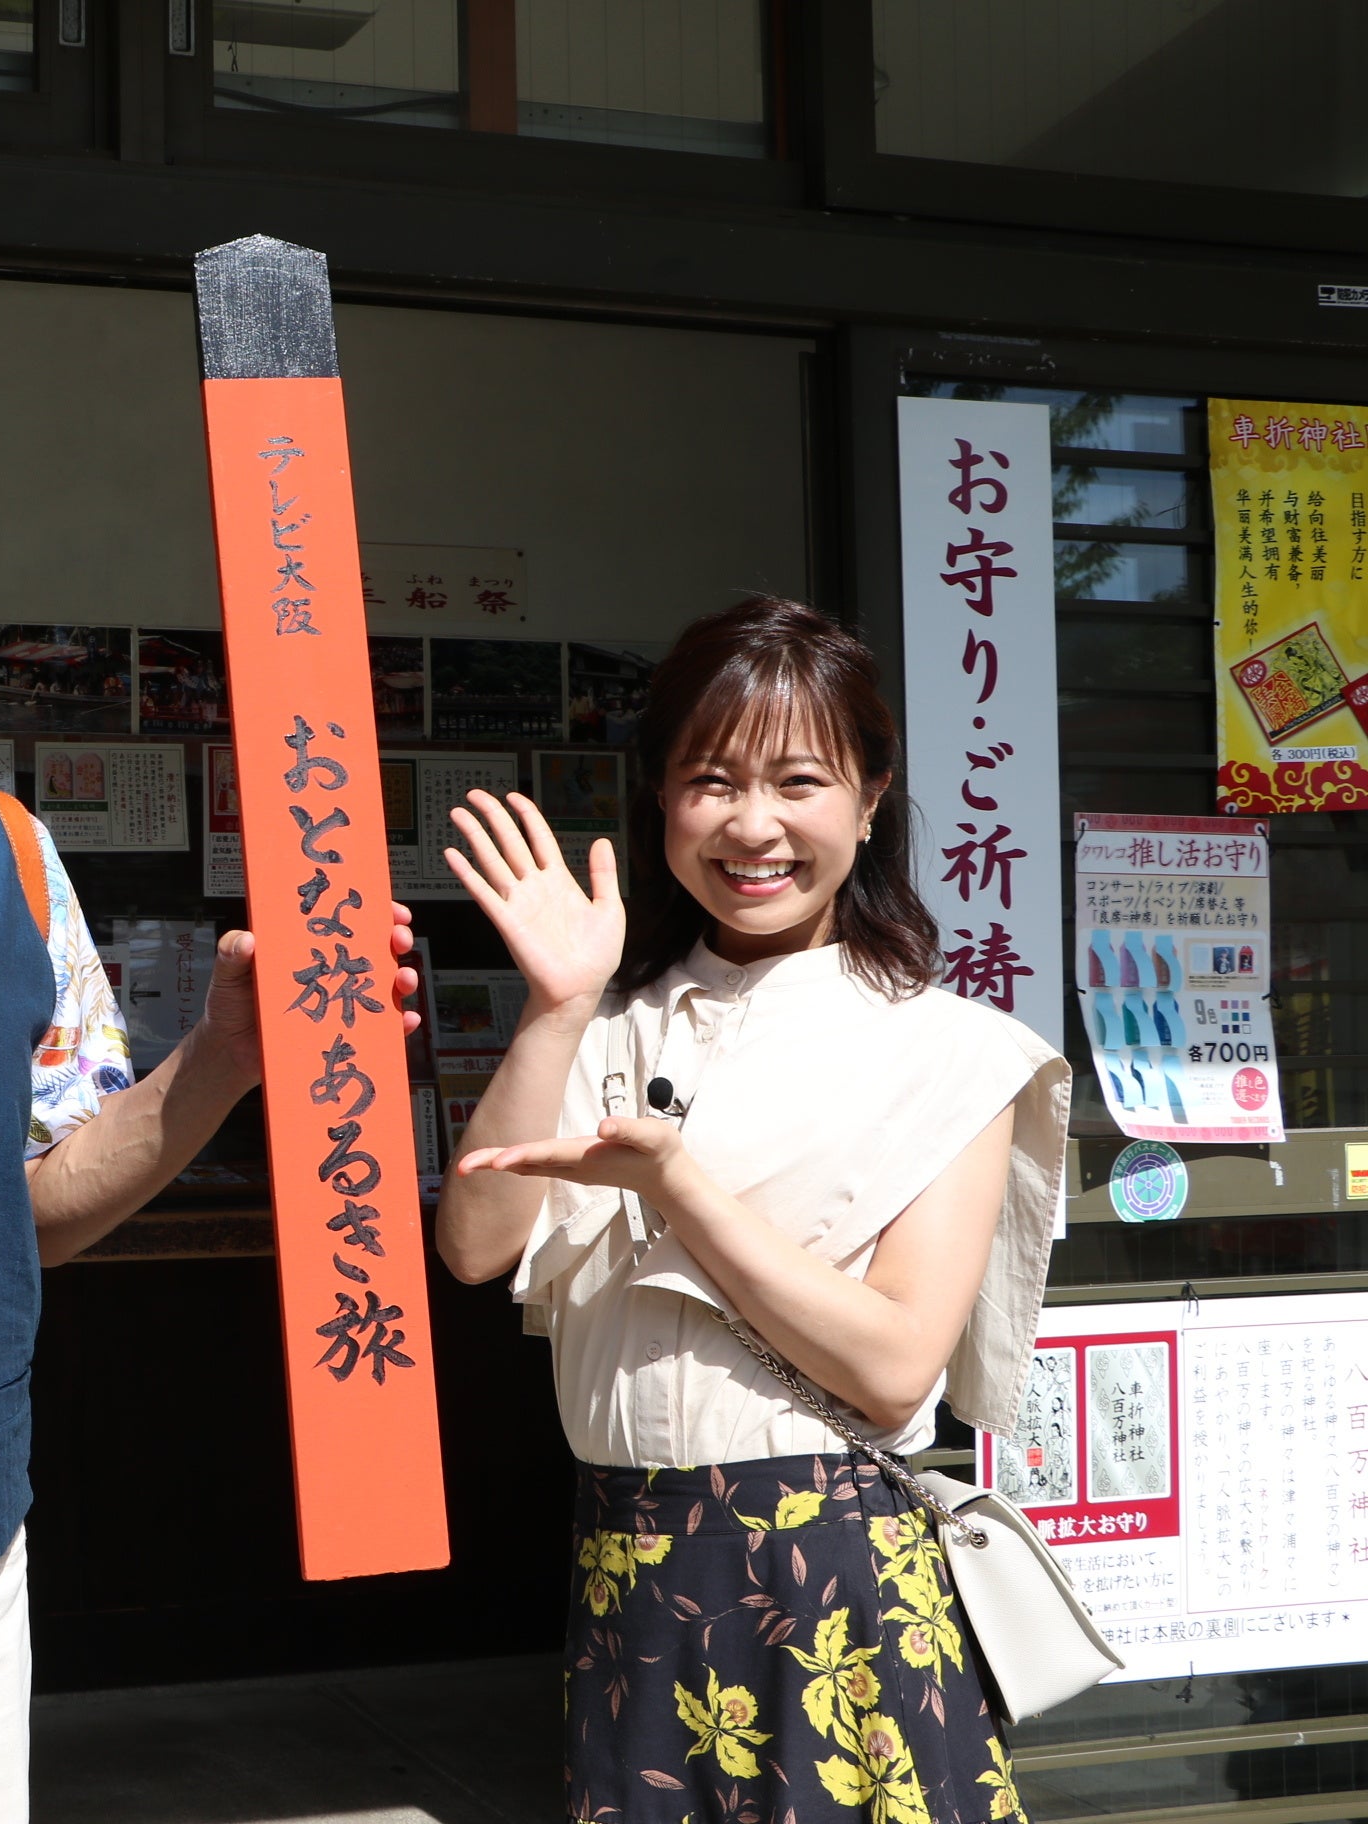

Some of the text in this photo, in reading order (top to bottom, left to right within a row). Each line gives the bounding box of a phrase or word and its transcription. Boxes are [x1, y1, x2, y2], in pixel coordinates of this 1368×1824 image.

[1229, 414, 1368, 452] 車折神社
[1258, 489, 1281, 581] 并希望拥有
[1307, 491, 1328, 581] 给向往美丽
[1350, 492, 1367, 581] 目指す方に
[363, 587, 518, 614] 三船祭
[940, 438, 1034, 1013] お守り・ご祈祷
[1272, 749, 1283, 761] 各
[1082, 837, 1262, 872] タワレコ推し活お守り
[257, 436, 415, 1386] テレビ大阪 おとな旅あるき旅
[1188, 1042, 1269, 1063] 各700円
[1026, 1384, 1042, 1447] 人脈拡大
[1110, 1382, 1128, 1464] 八百万神社
[1128, 1381, 1146, 1463] 車折神社
[1038, 1512, 1148, 1540] 脈拡大お守り
